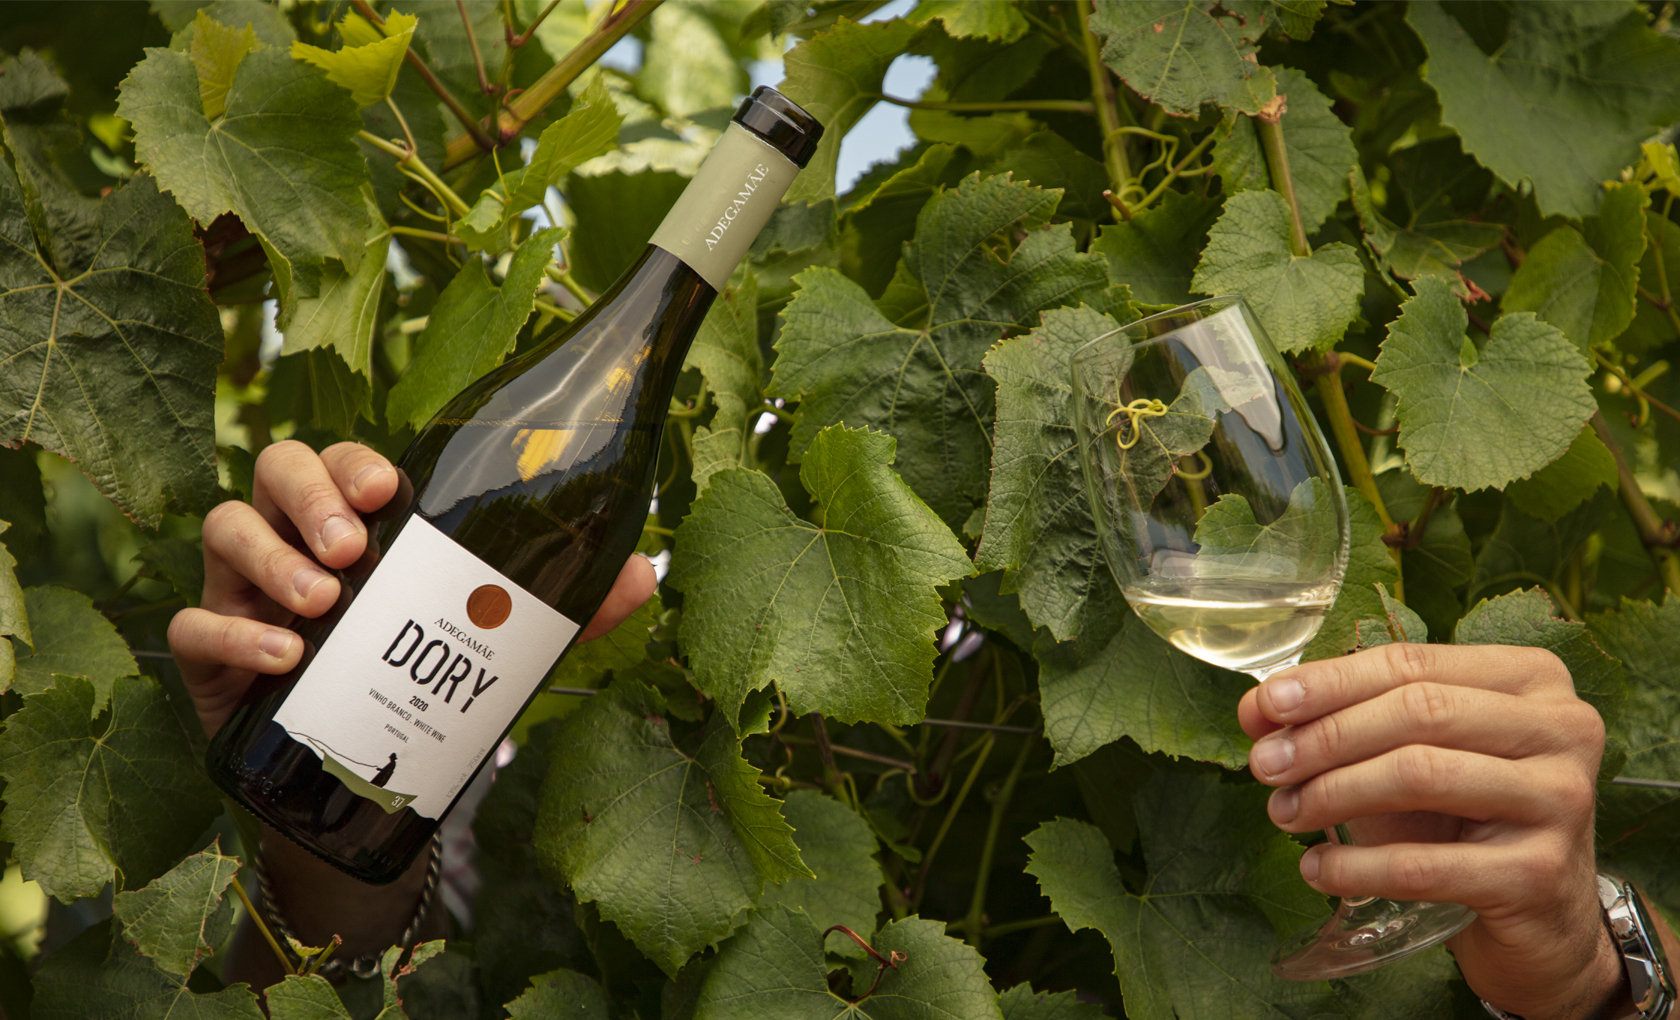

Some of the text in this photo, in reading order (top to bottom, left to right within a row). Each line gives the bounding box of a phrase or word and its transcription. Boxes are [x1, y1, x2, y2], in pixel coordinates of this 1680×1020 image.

[705, 163, 769, 252] ADEGAMÃE
[434, 617, 495, 661] ADEGAMÃE
[381, 618, 499, 714] DORY
[368, 687, 388, 705] VINHO
[386, 700, 412, 721] BRANCO
[413, 718, 433, 735] WHITE
[430, 729, 447, 743] WINE
[409, 695, 429, 712] 2020
[383, 723, 409, 743] PORTUGAL
[445, 784, 460, 798] 13%
[466, 747, 486, 769] 750ml
[391, 795, 405, 808] 37
